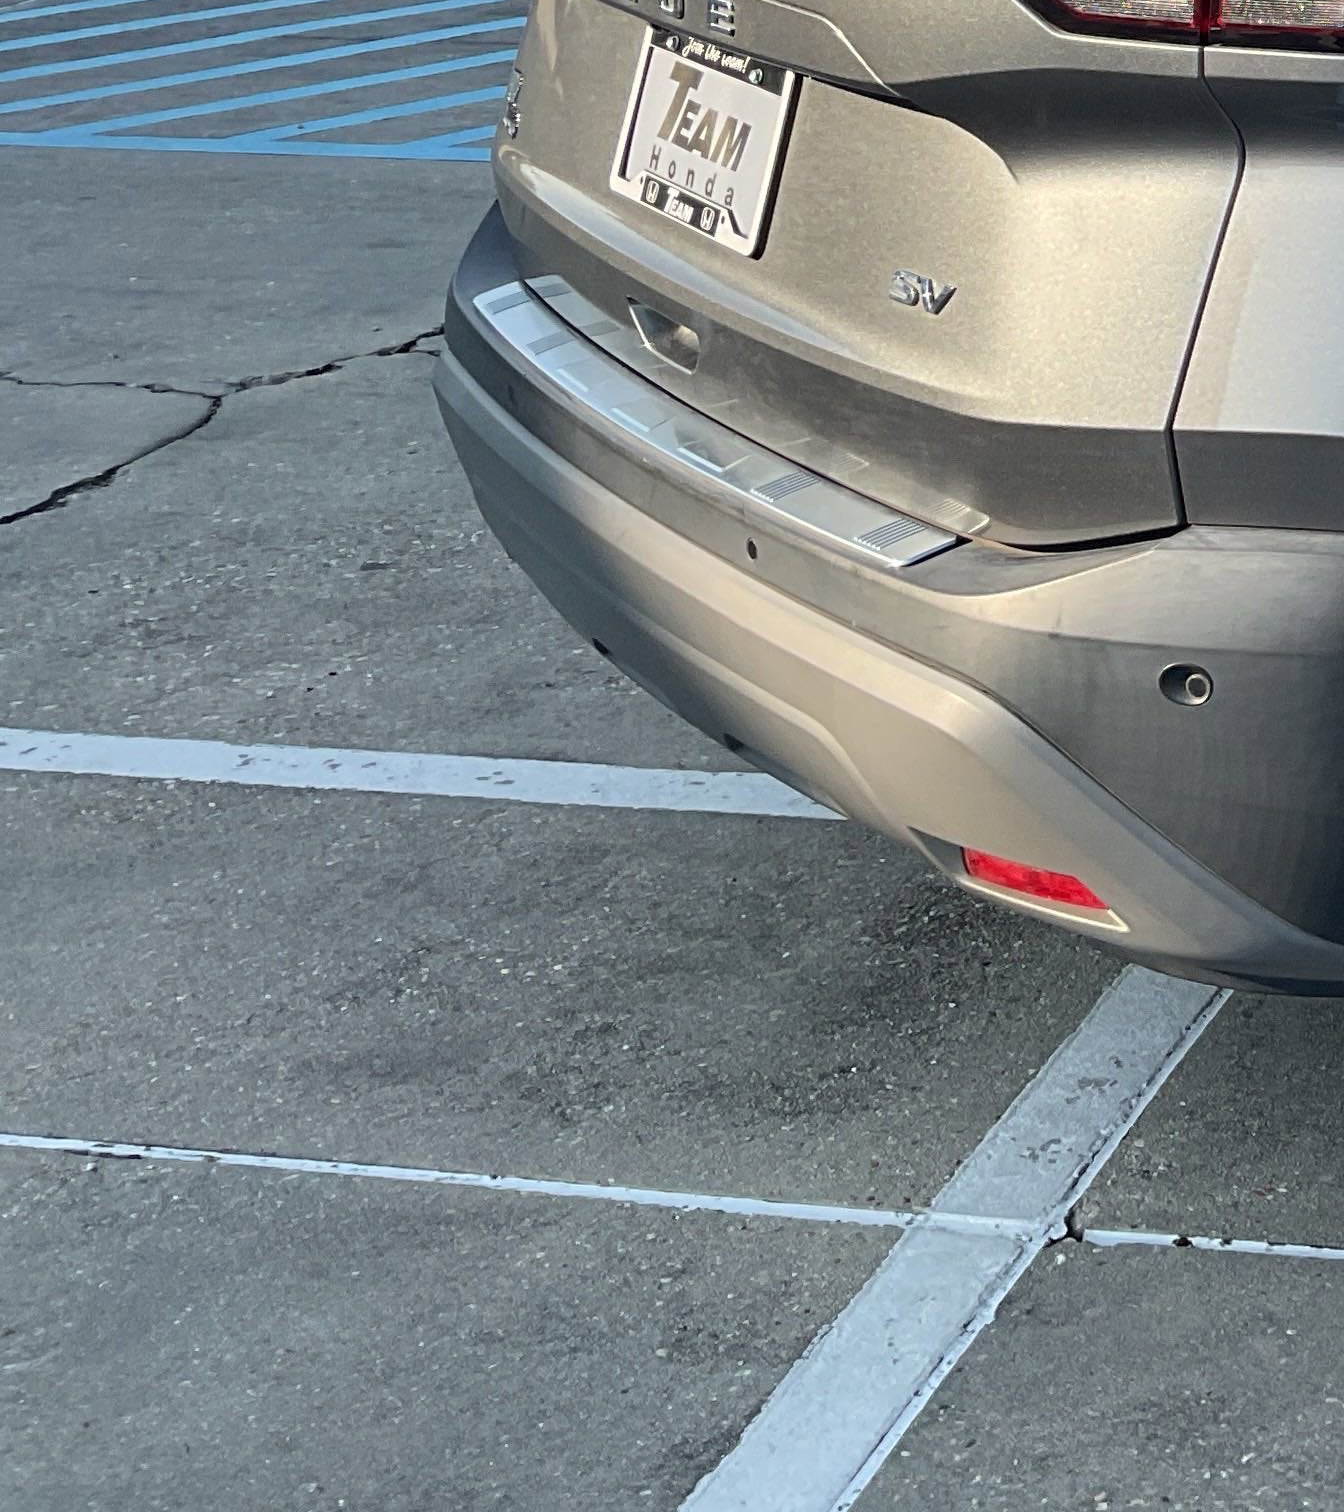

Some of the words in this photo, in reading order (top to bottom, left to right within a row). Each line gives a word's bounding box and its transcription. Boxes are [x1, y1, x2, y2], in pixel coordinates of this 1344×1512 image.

[656, 60, 752, 173] TEAM
[649, 144, 736, 207] Honda
[888, 268, 957, 316] SV
